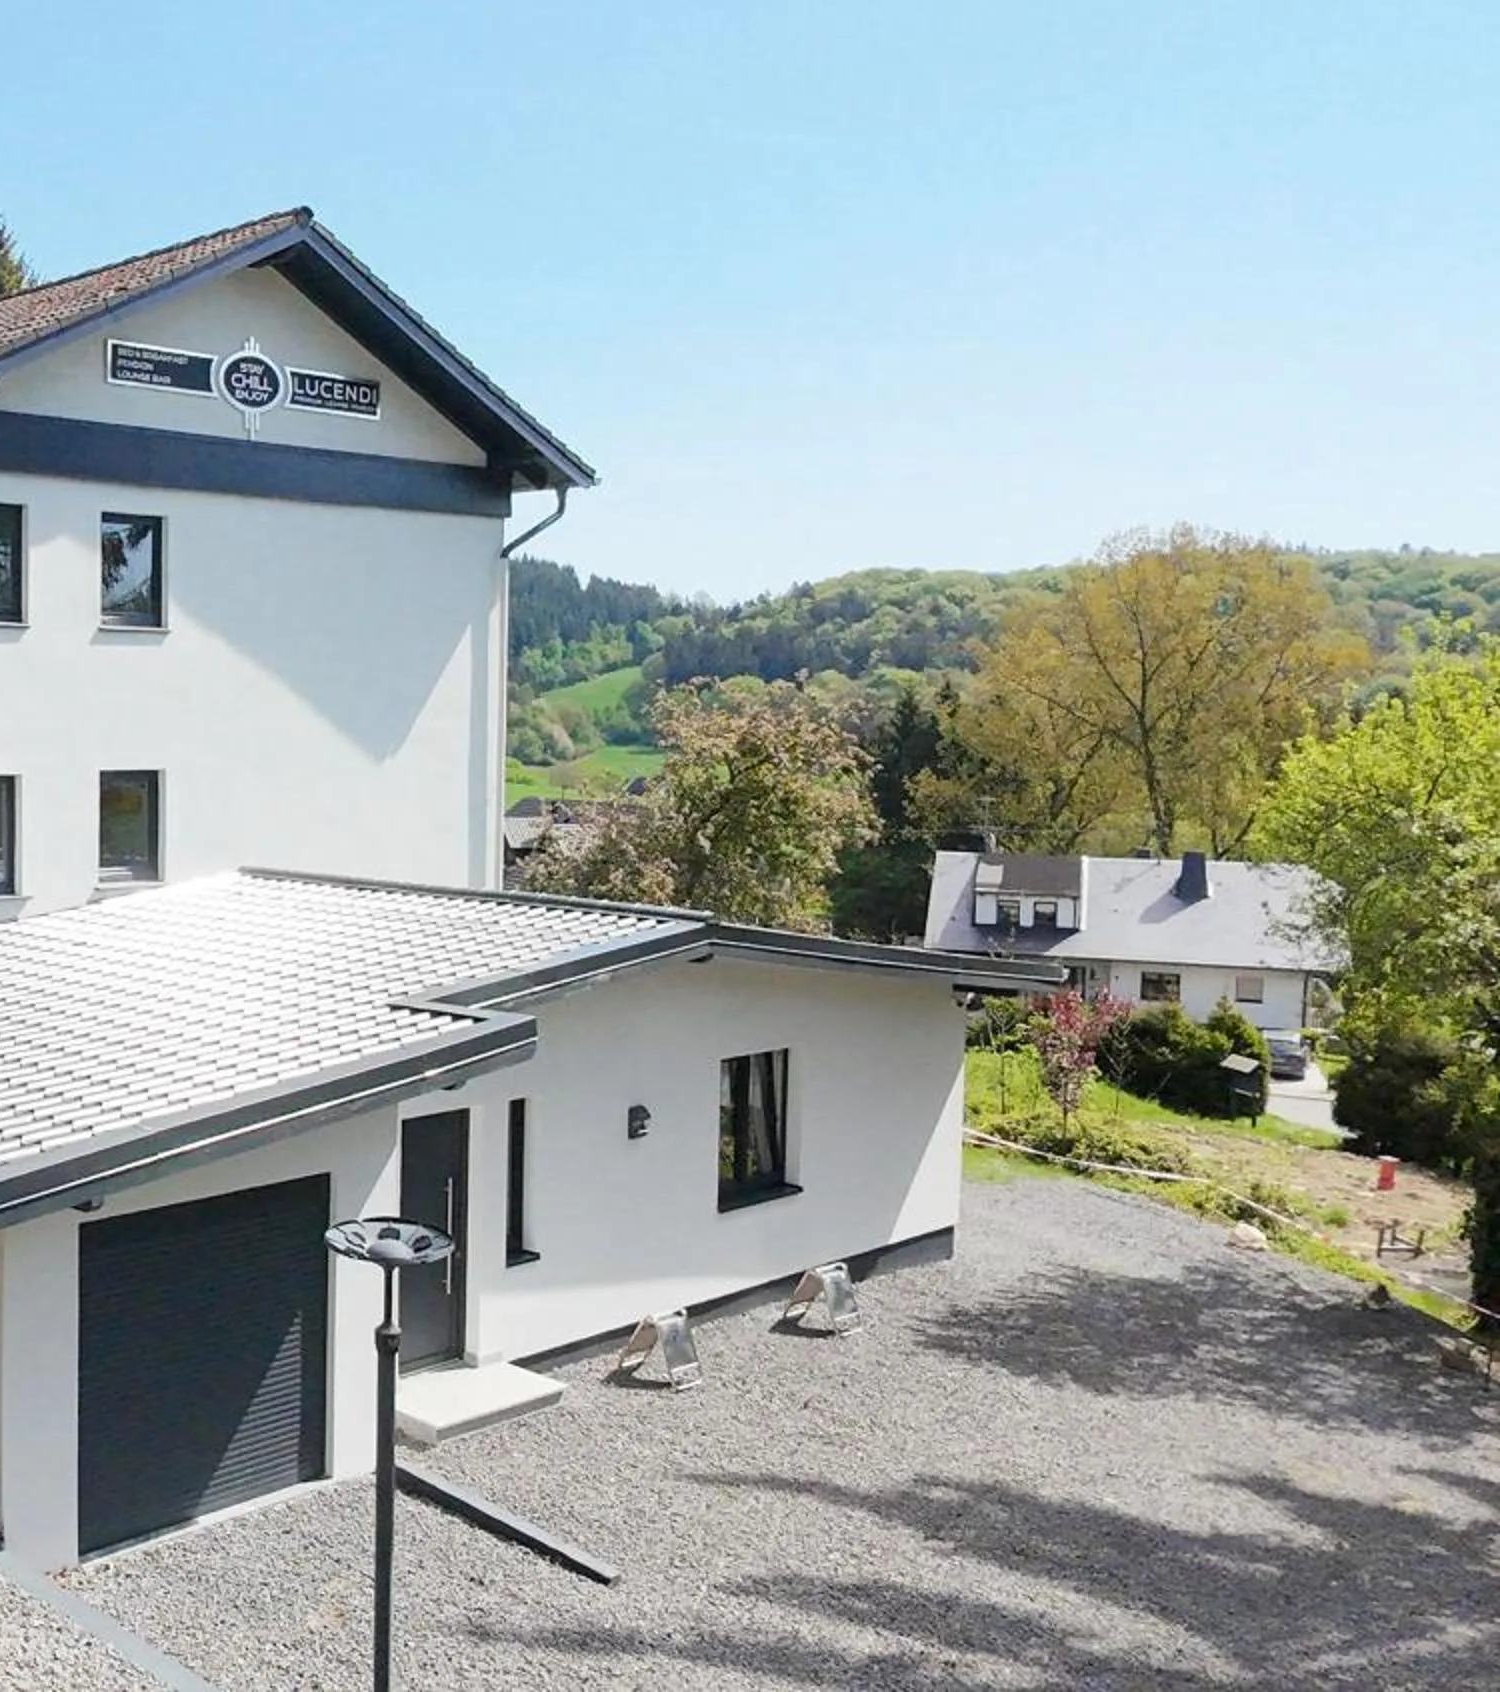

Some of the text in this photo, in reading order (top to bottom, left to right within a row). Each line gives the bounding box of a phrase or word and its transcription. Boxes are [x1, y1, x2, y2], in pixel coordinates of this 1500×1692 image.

[240, 363, 265, 376] STAY
[231, 373, 273, 391] CHILL
[235, 389, 269, 402] ENJOY
[293, 376, 377, 404] LUCENDI
